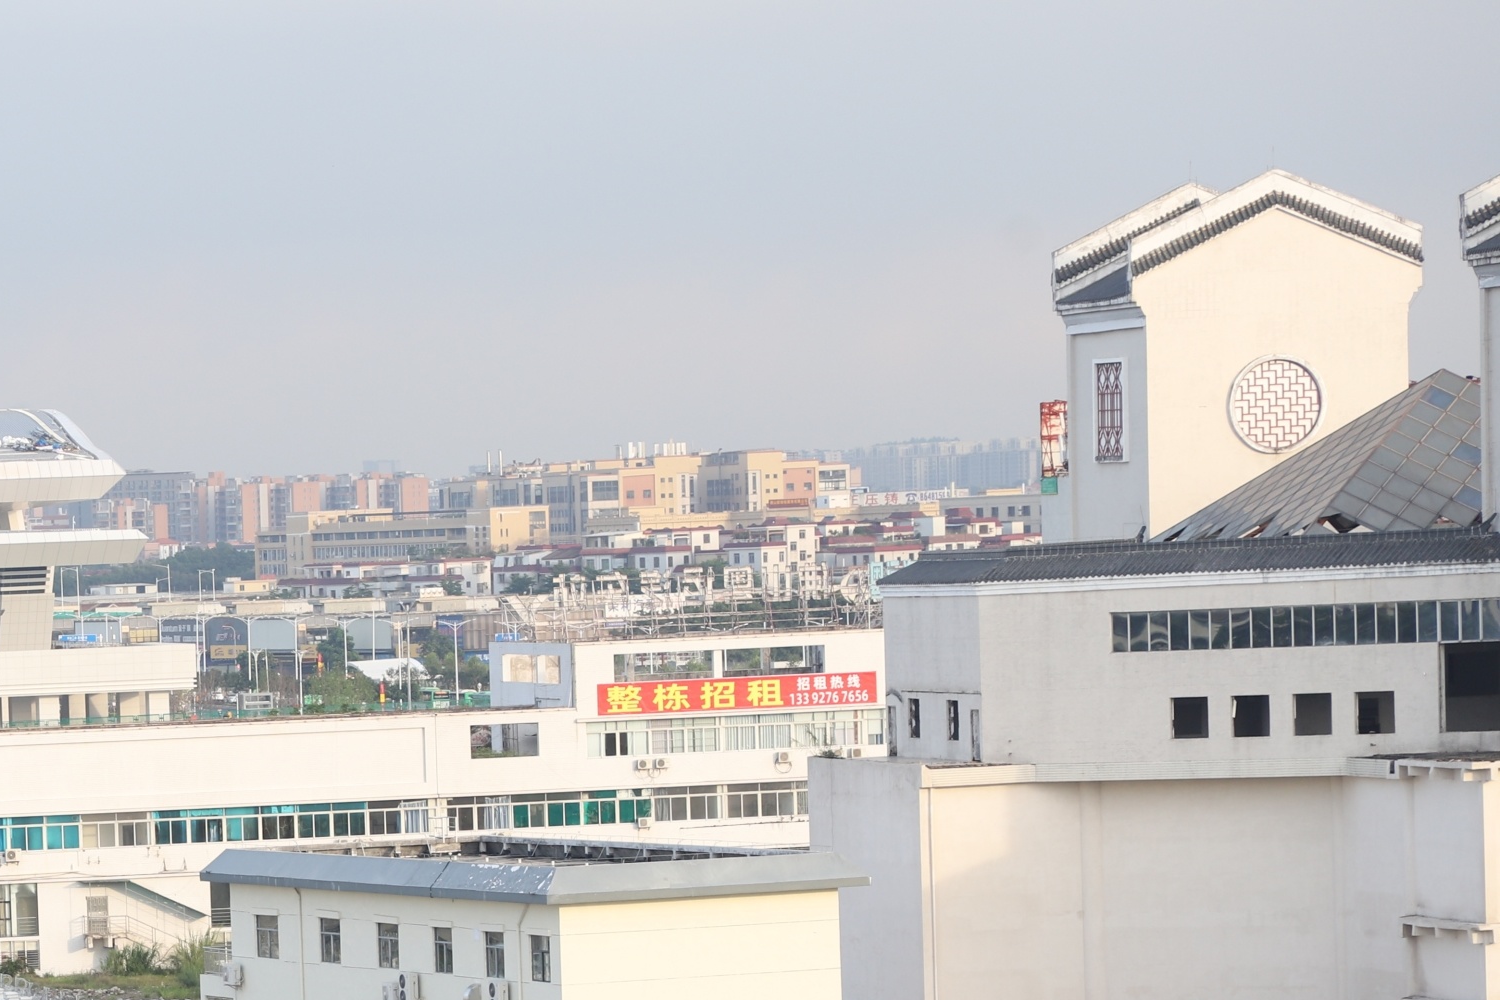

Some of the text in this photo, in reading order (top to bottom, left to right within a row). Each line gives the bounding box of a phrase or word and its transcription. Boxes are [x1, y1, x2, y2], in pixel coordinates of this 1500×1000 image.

[797, 674, 861, 691] 招租热线
[606, 679, 784, 713] 整栋招租
[789, 689, 869, 705] 133 9276 7656
